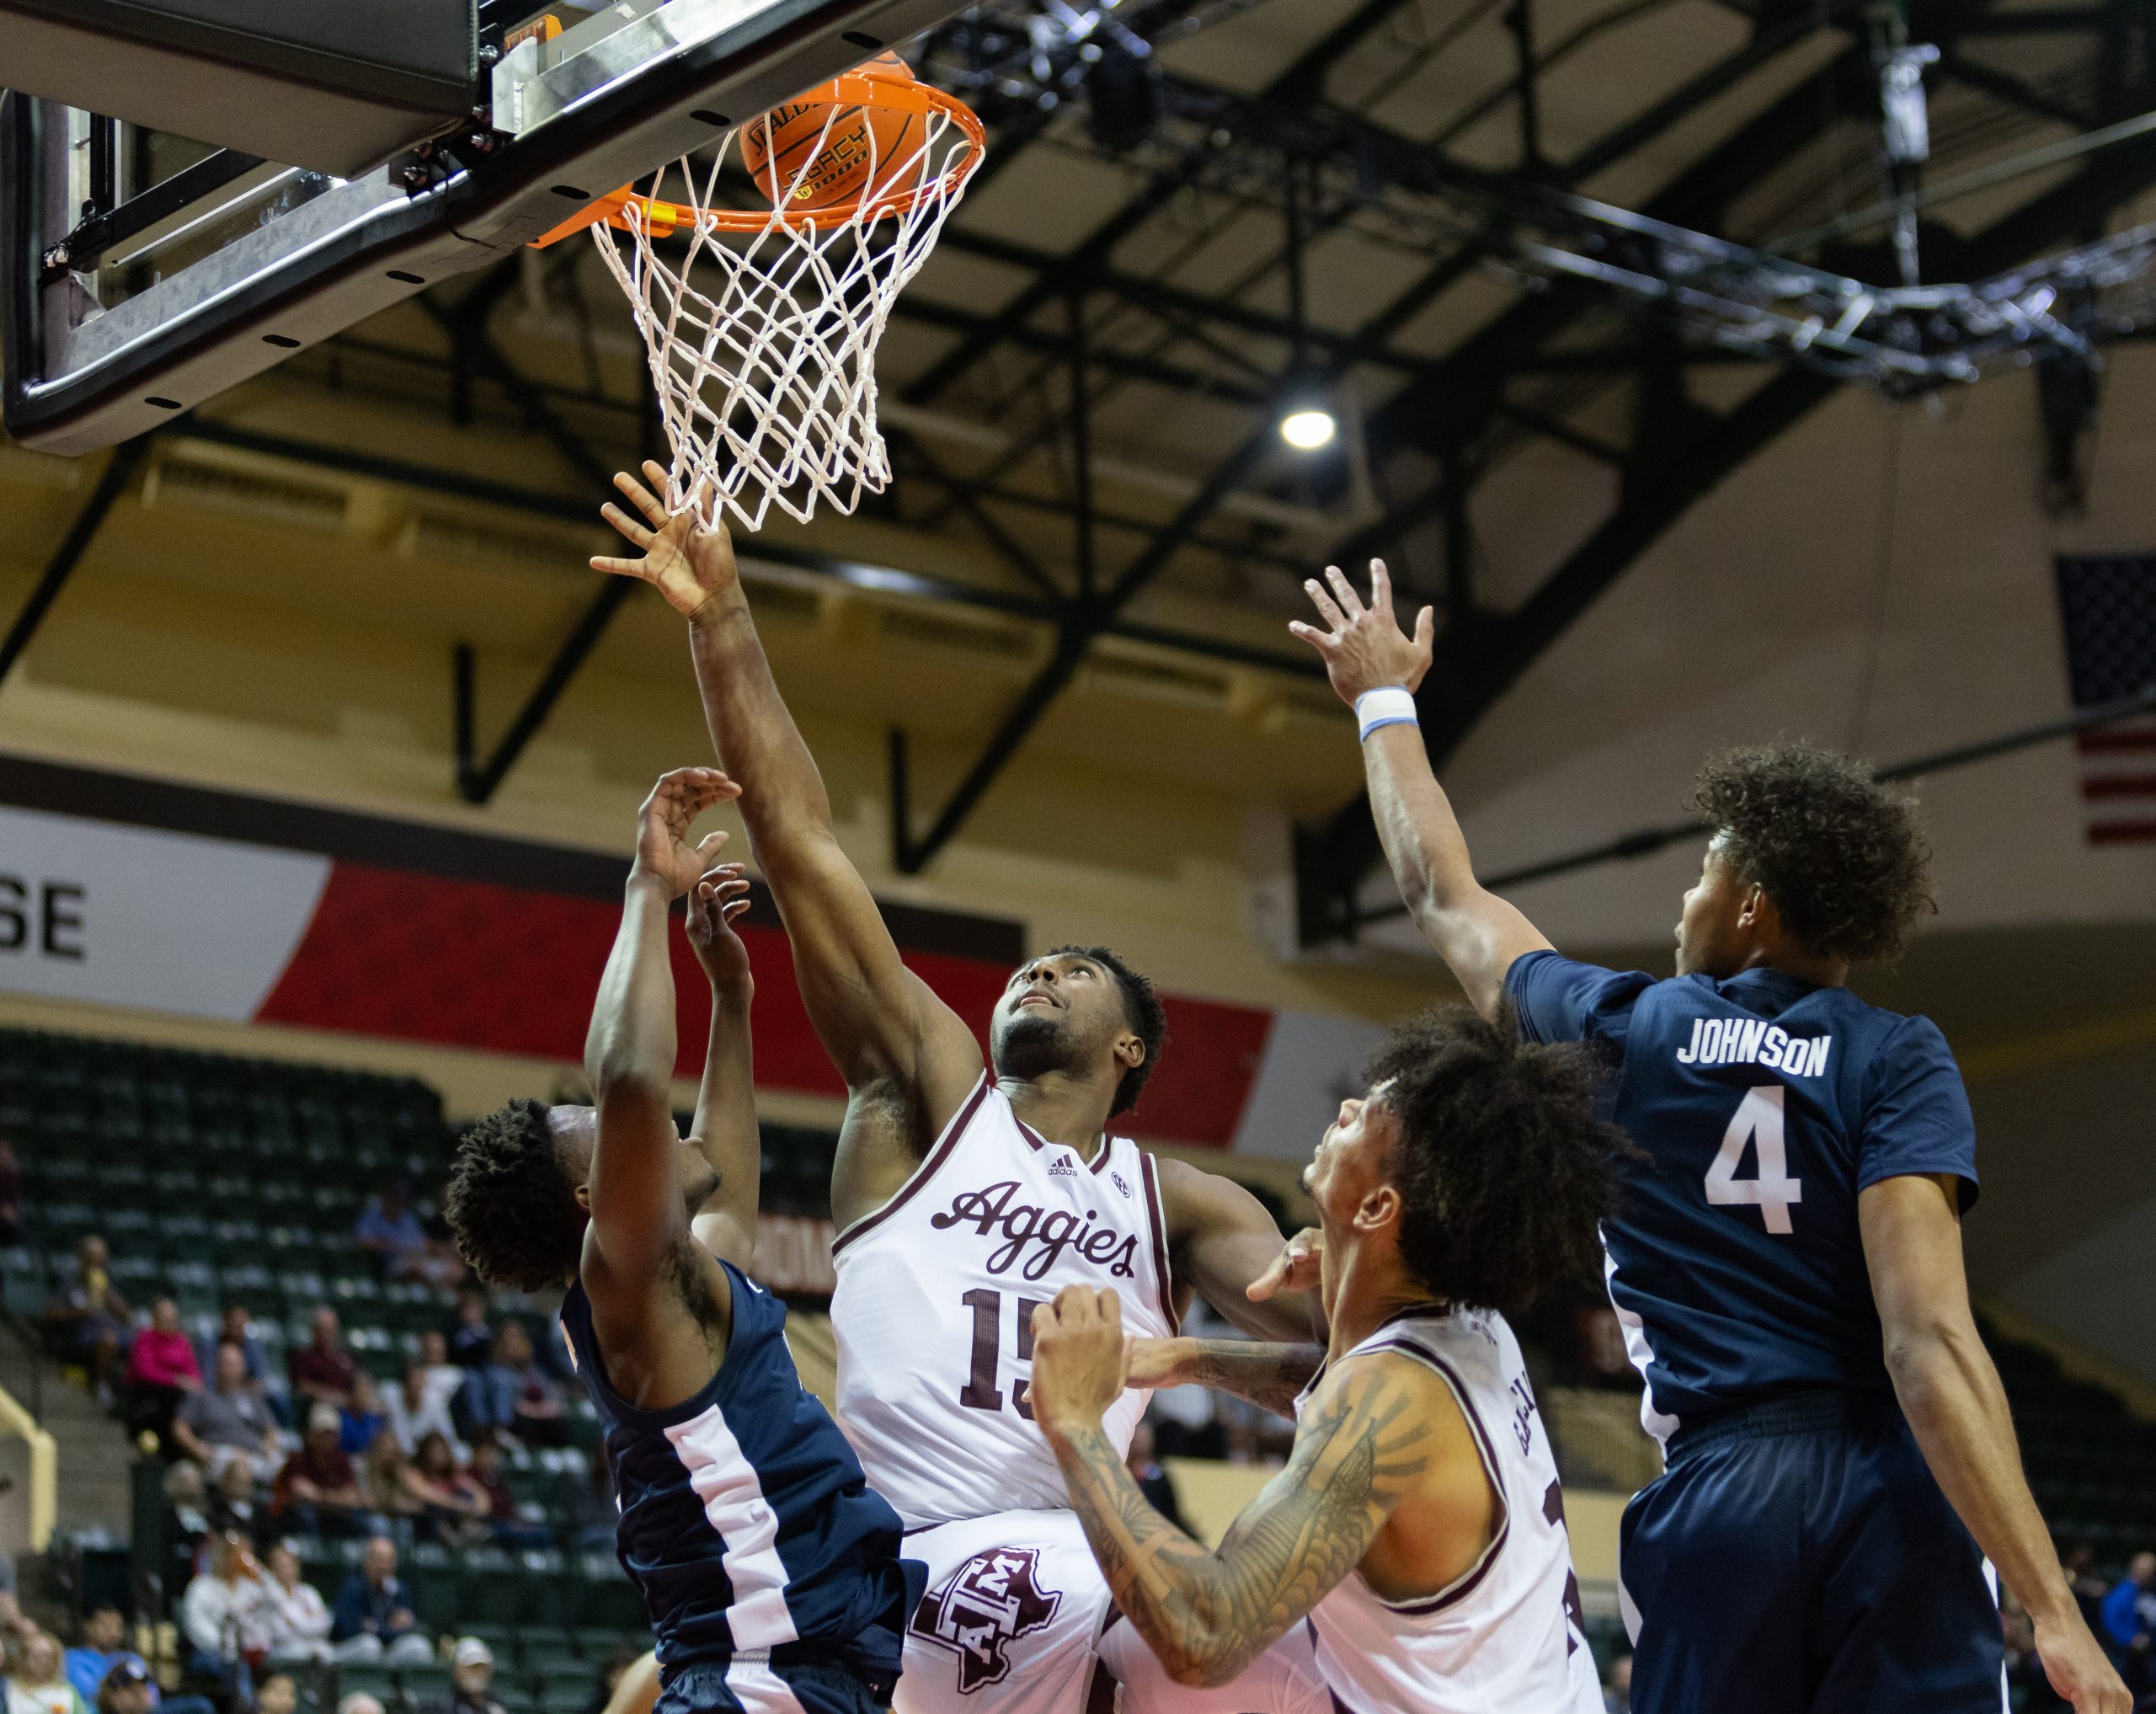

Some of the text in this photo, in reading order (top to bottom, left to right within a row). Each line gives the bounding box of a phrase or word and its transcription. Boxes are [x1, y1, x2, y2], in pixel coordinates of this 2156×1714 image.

[811, 148, 868, 190] 1000
[1676, 1018, 1832, 1077] JOHNSON
[1048, 1167, 1078, 1177] adidas
[1113, 1173, 1129, 1197] SEC
[1704, 1086, 1802, 1235] 4
[931, 1181, 1139, 1281] Aggies
